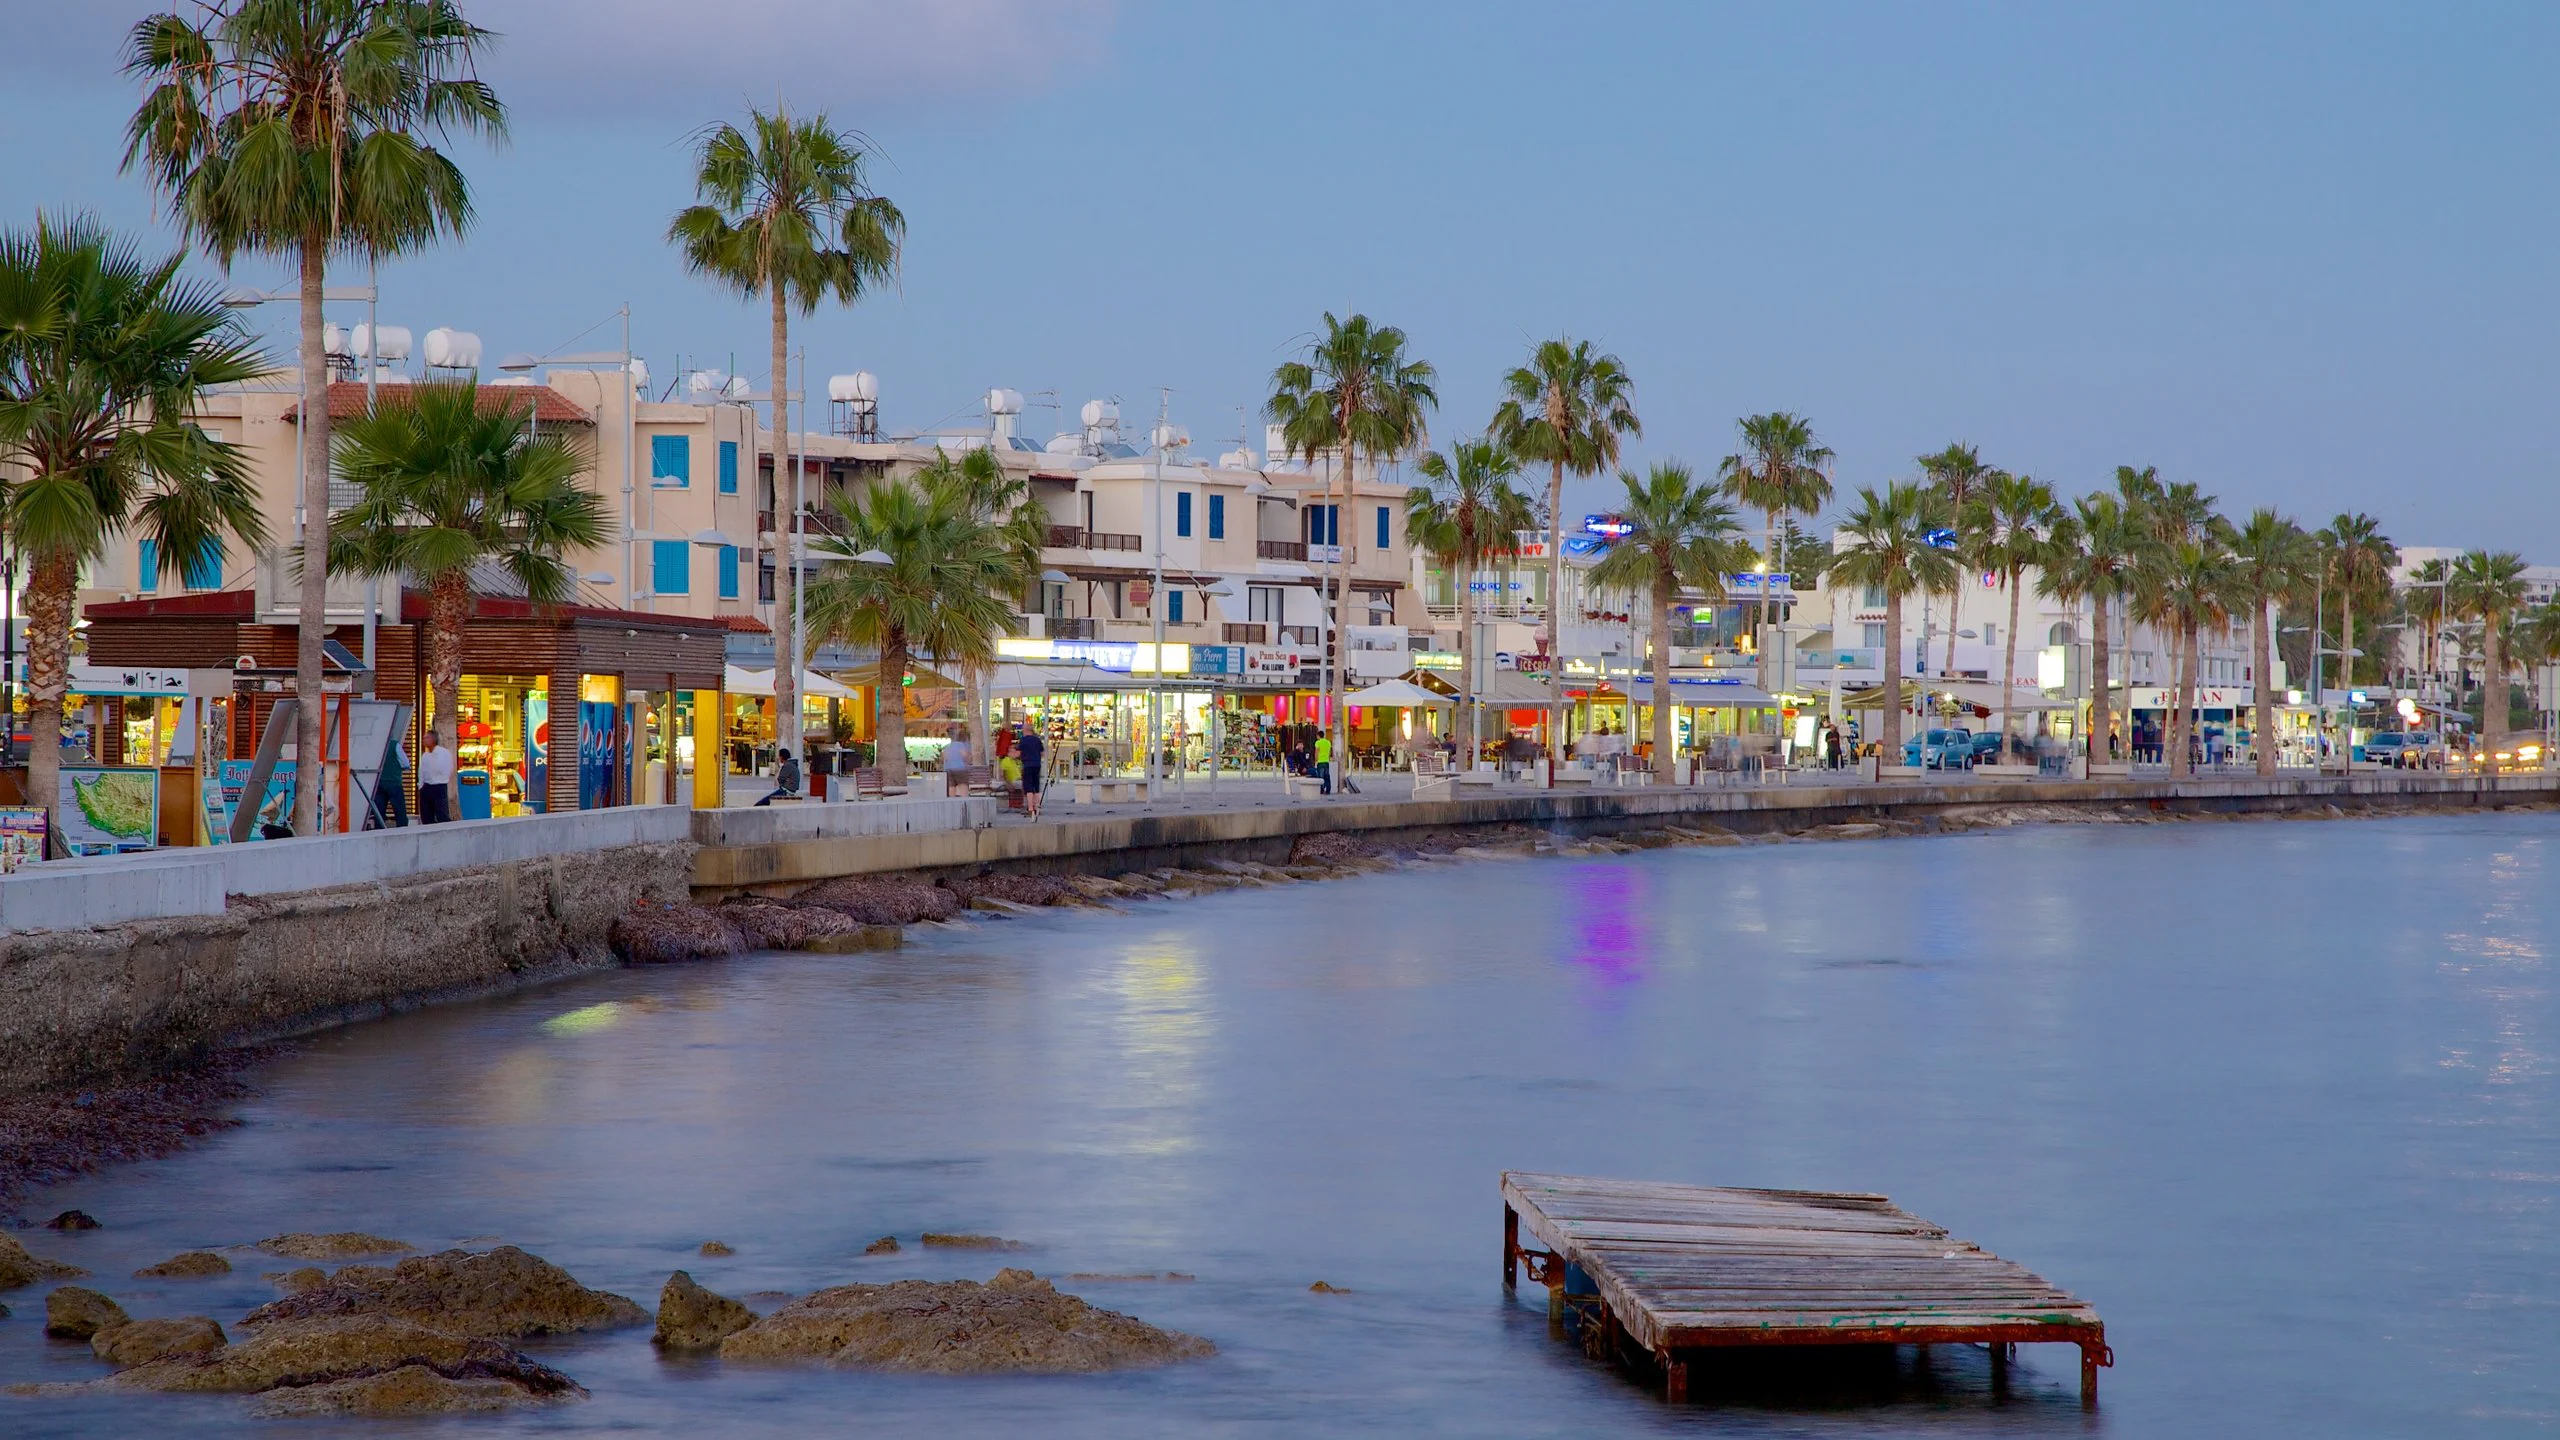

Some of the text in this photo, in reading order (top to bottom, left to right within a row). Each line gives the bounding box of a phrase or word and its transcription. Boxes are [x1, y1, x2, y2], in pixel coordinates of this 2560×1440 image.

[1084, 646, 1120, 667] VIEW
[1259, 650, 1287, 660] Pam Sea
[1520, 660, 1532, 671] ICE
